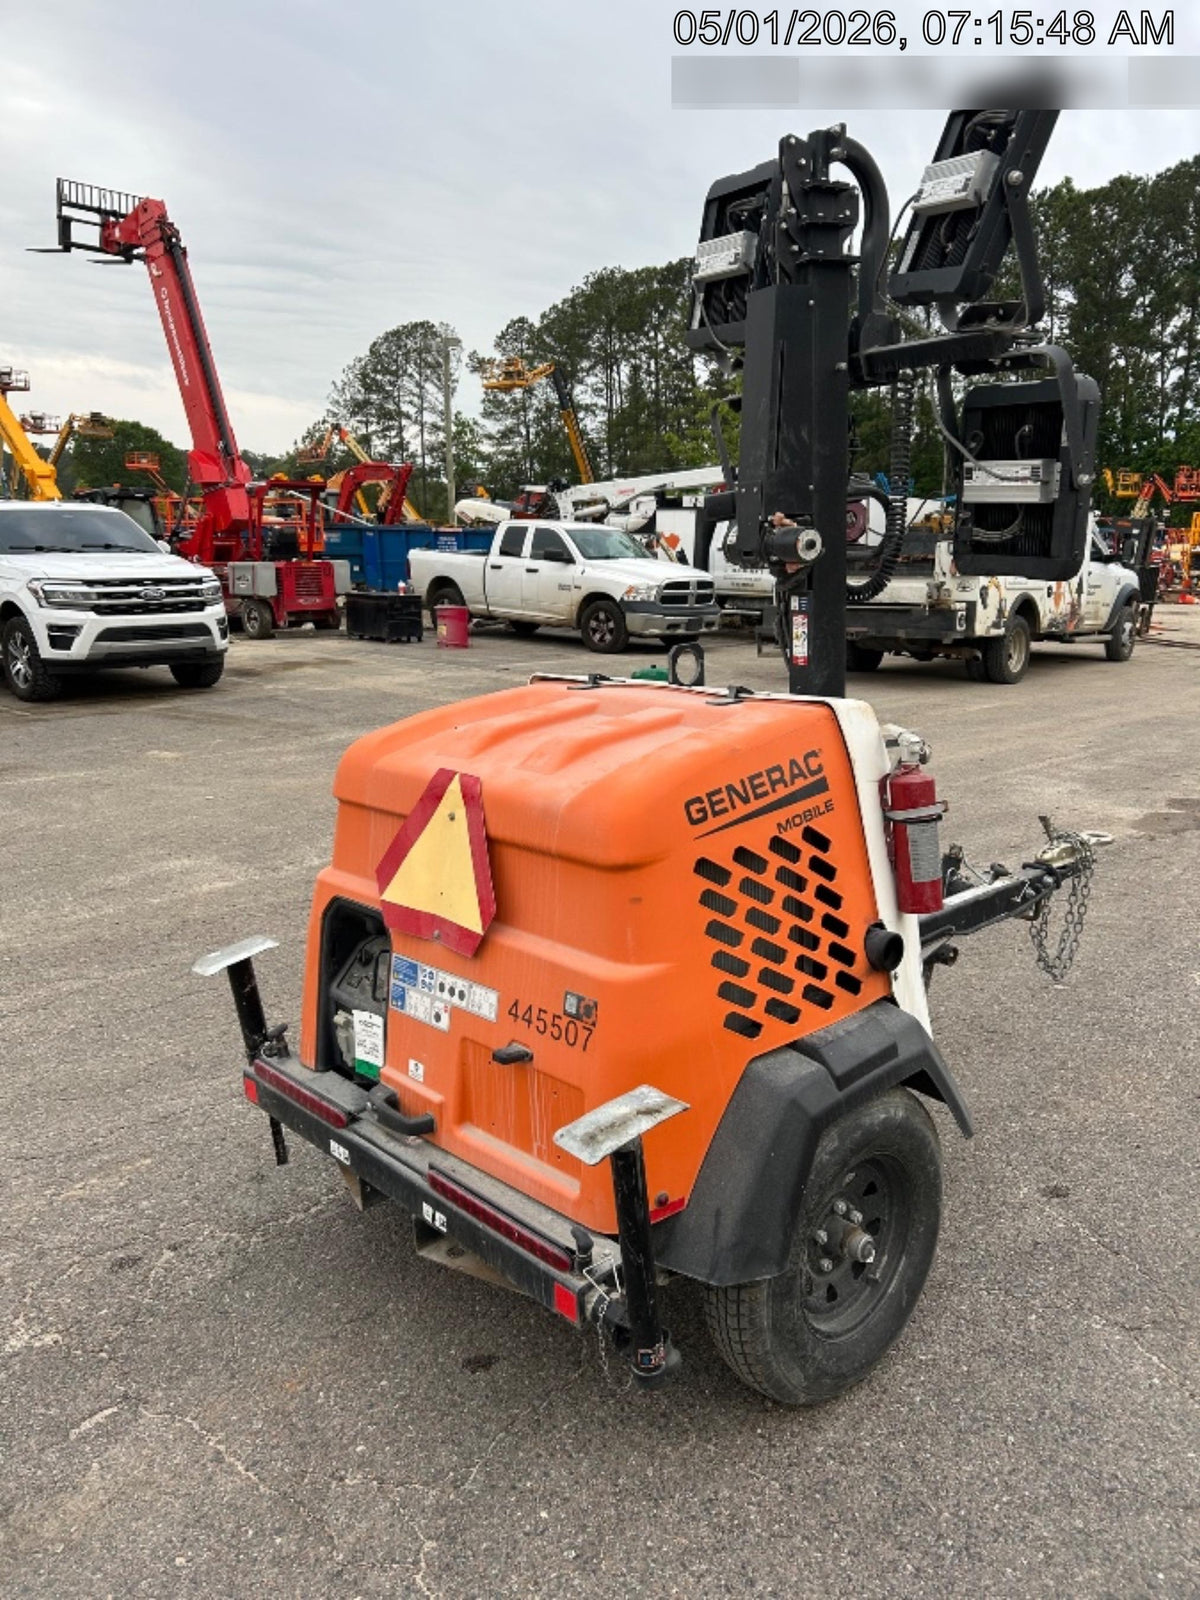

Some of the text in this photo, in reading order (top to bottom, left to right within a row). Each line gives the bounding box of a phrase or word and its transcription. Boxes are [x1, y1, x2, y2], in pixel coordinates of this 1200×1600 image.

[684, 750, 824, 826] GENERAC
[776, 798, 835, 834] MOBILE
[508, 998, 593, 1052] 445507
